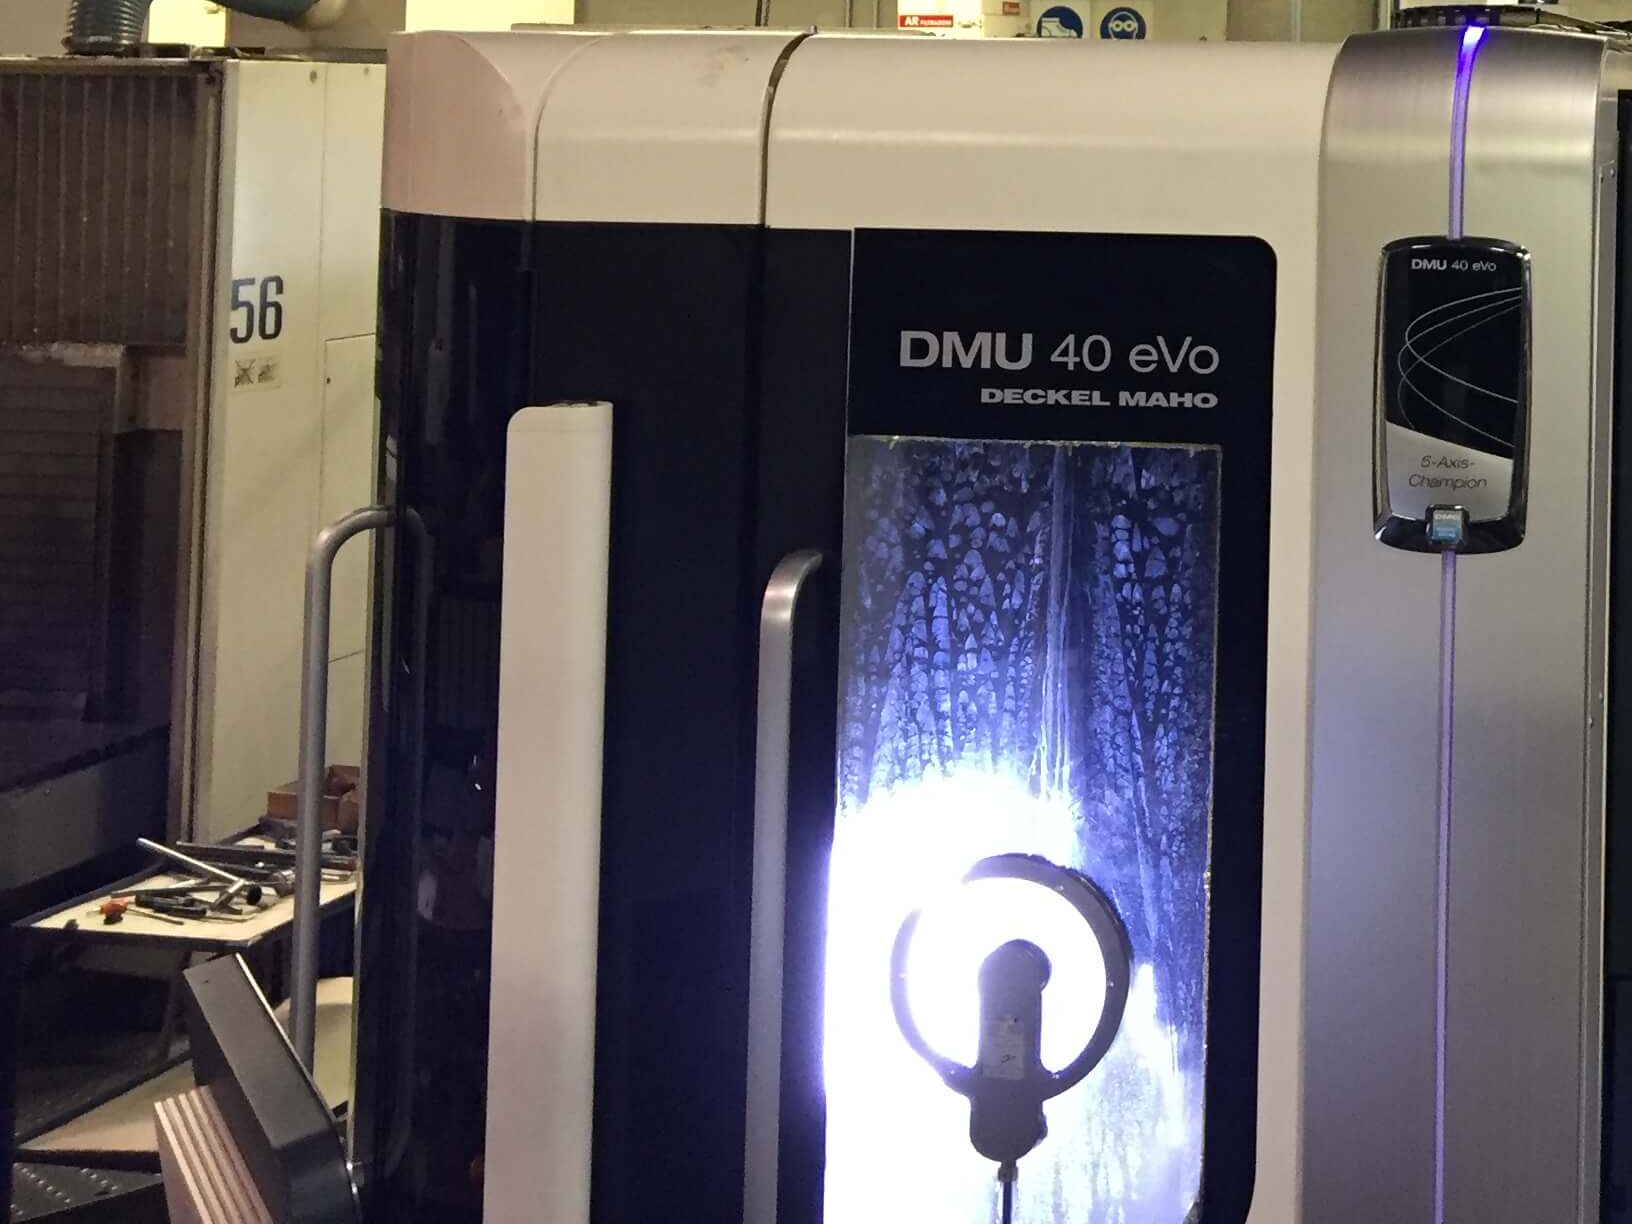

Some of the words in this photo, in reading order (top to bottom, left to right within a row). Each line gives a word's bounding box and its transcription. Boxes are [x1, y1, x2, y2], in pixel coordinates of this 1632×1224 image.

[904, 15, 920, 26] AR
[1410, 258, 1448, 272] DMU
[1451, 260, 1469, 272] 40
[1472, 260, 1498, 273] eVo
[229, 275, 285, 344] 56
[899, 329, 1034, 371] DMU
[1049, 333, 1113, 373] 40
[1128, 335, 1221, 375] eVo
[980, 387, 1111, 407] DECKEL
[1118, 390, 1220, 409] MAHO
[1407, 474, 1488, 490] Champion
